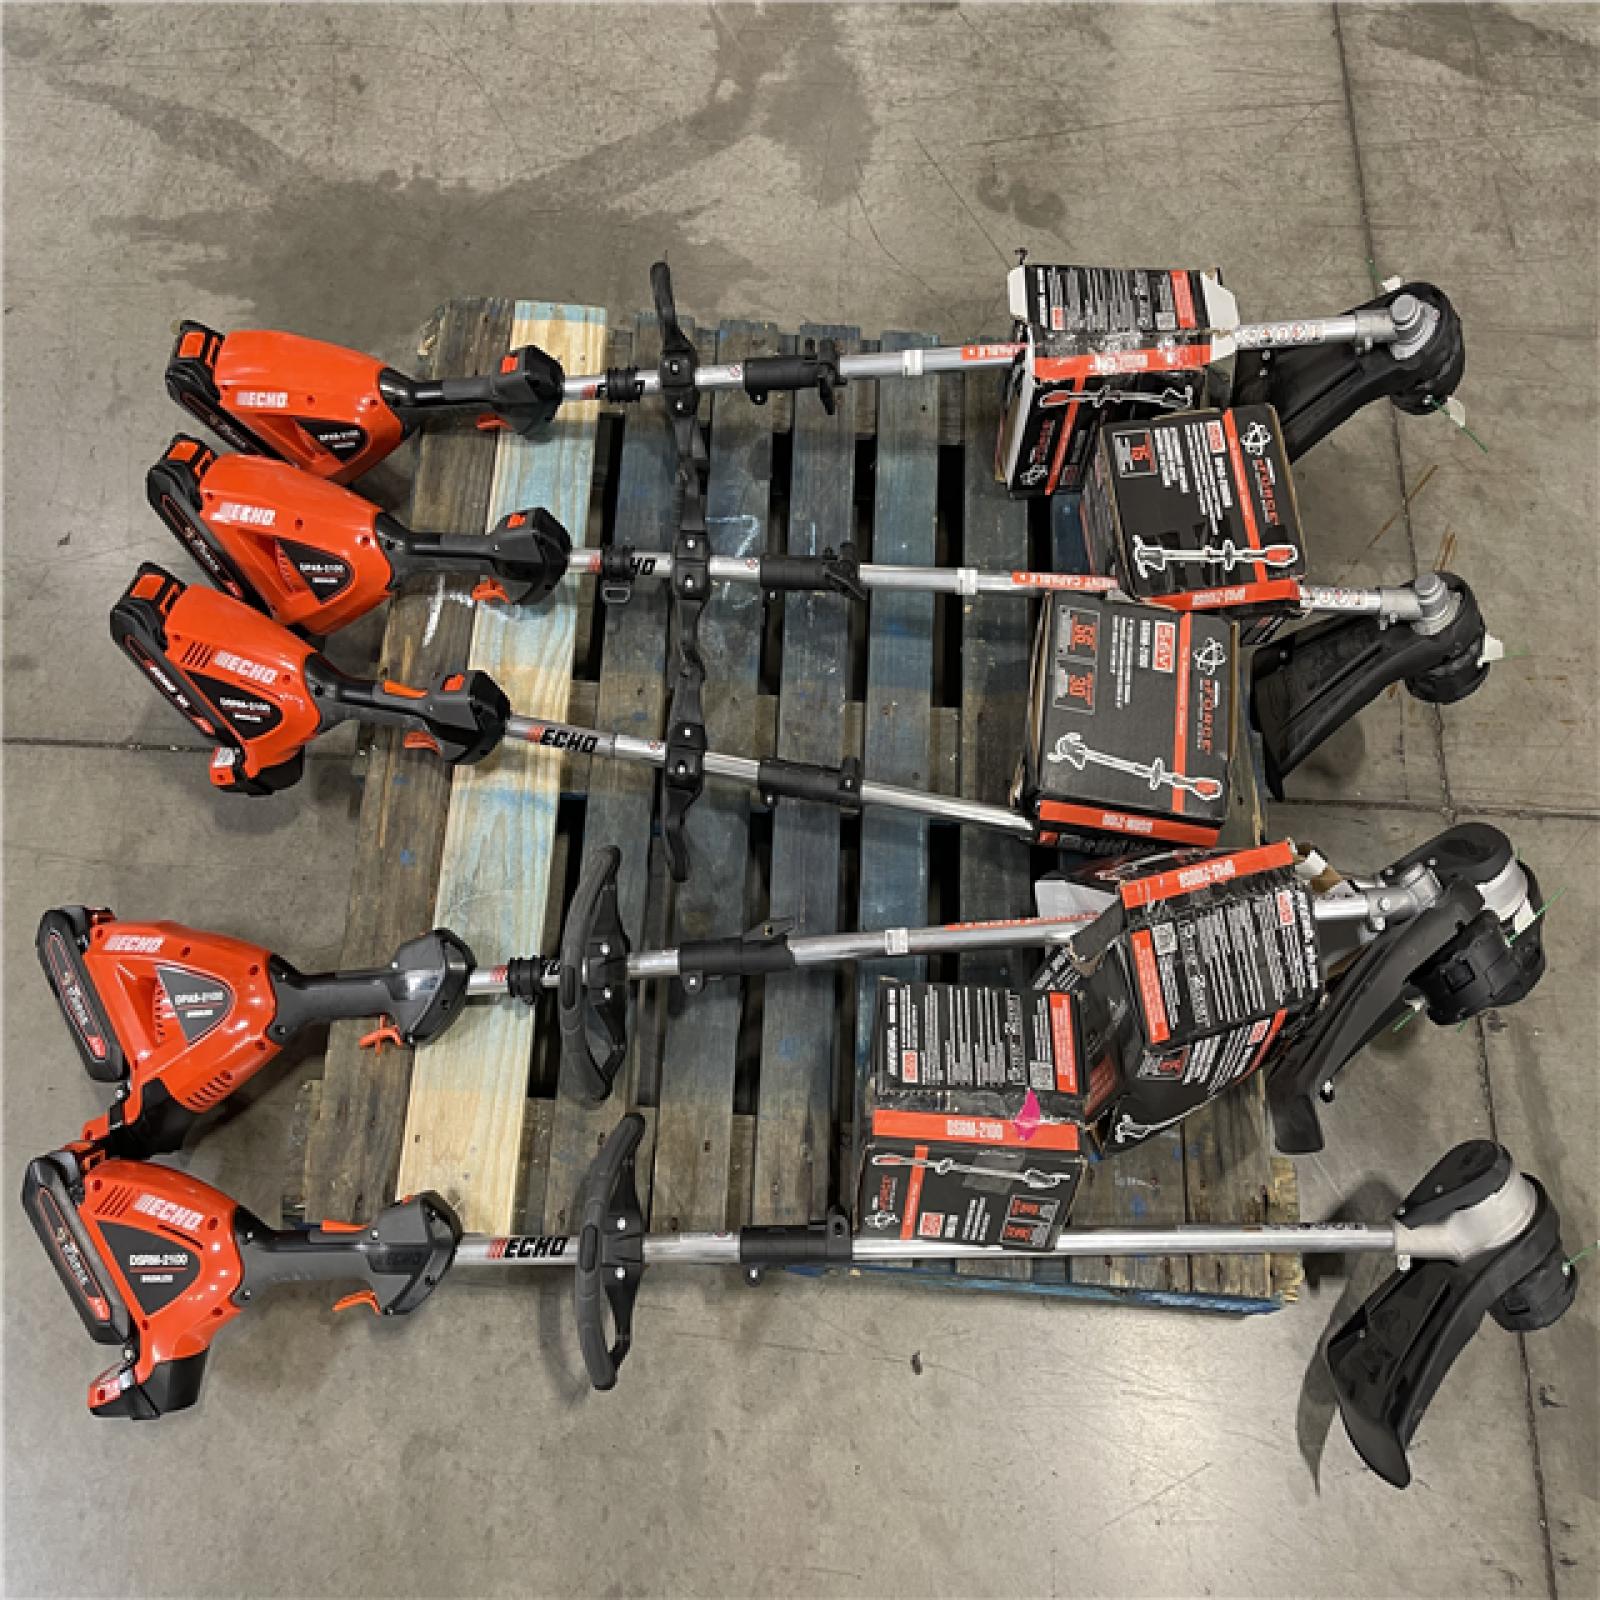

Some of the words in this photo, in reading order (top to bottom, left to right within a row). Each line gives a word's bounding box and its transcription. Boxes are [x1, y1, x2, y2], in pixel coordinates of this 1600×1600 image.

[228, 655, 278, 685] ECHO
[540, 729, 598, 753] ECHO
[118, 935, 165, 953] ECHO
[149, 1198, 205, 1231] ECHO
[504, 1236, 570, 1258] ECHO
